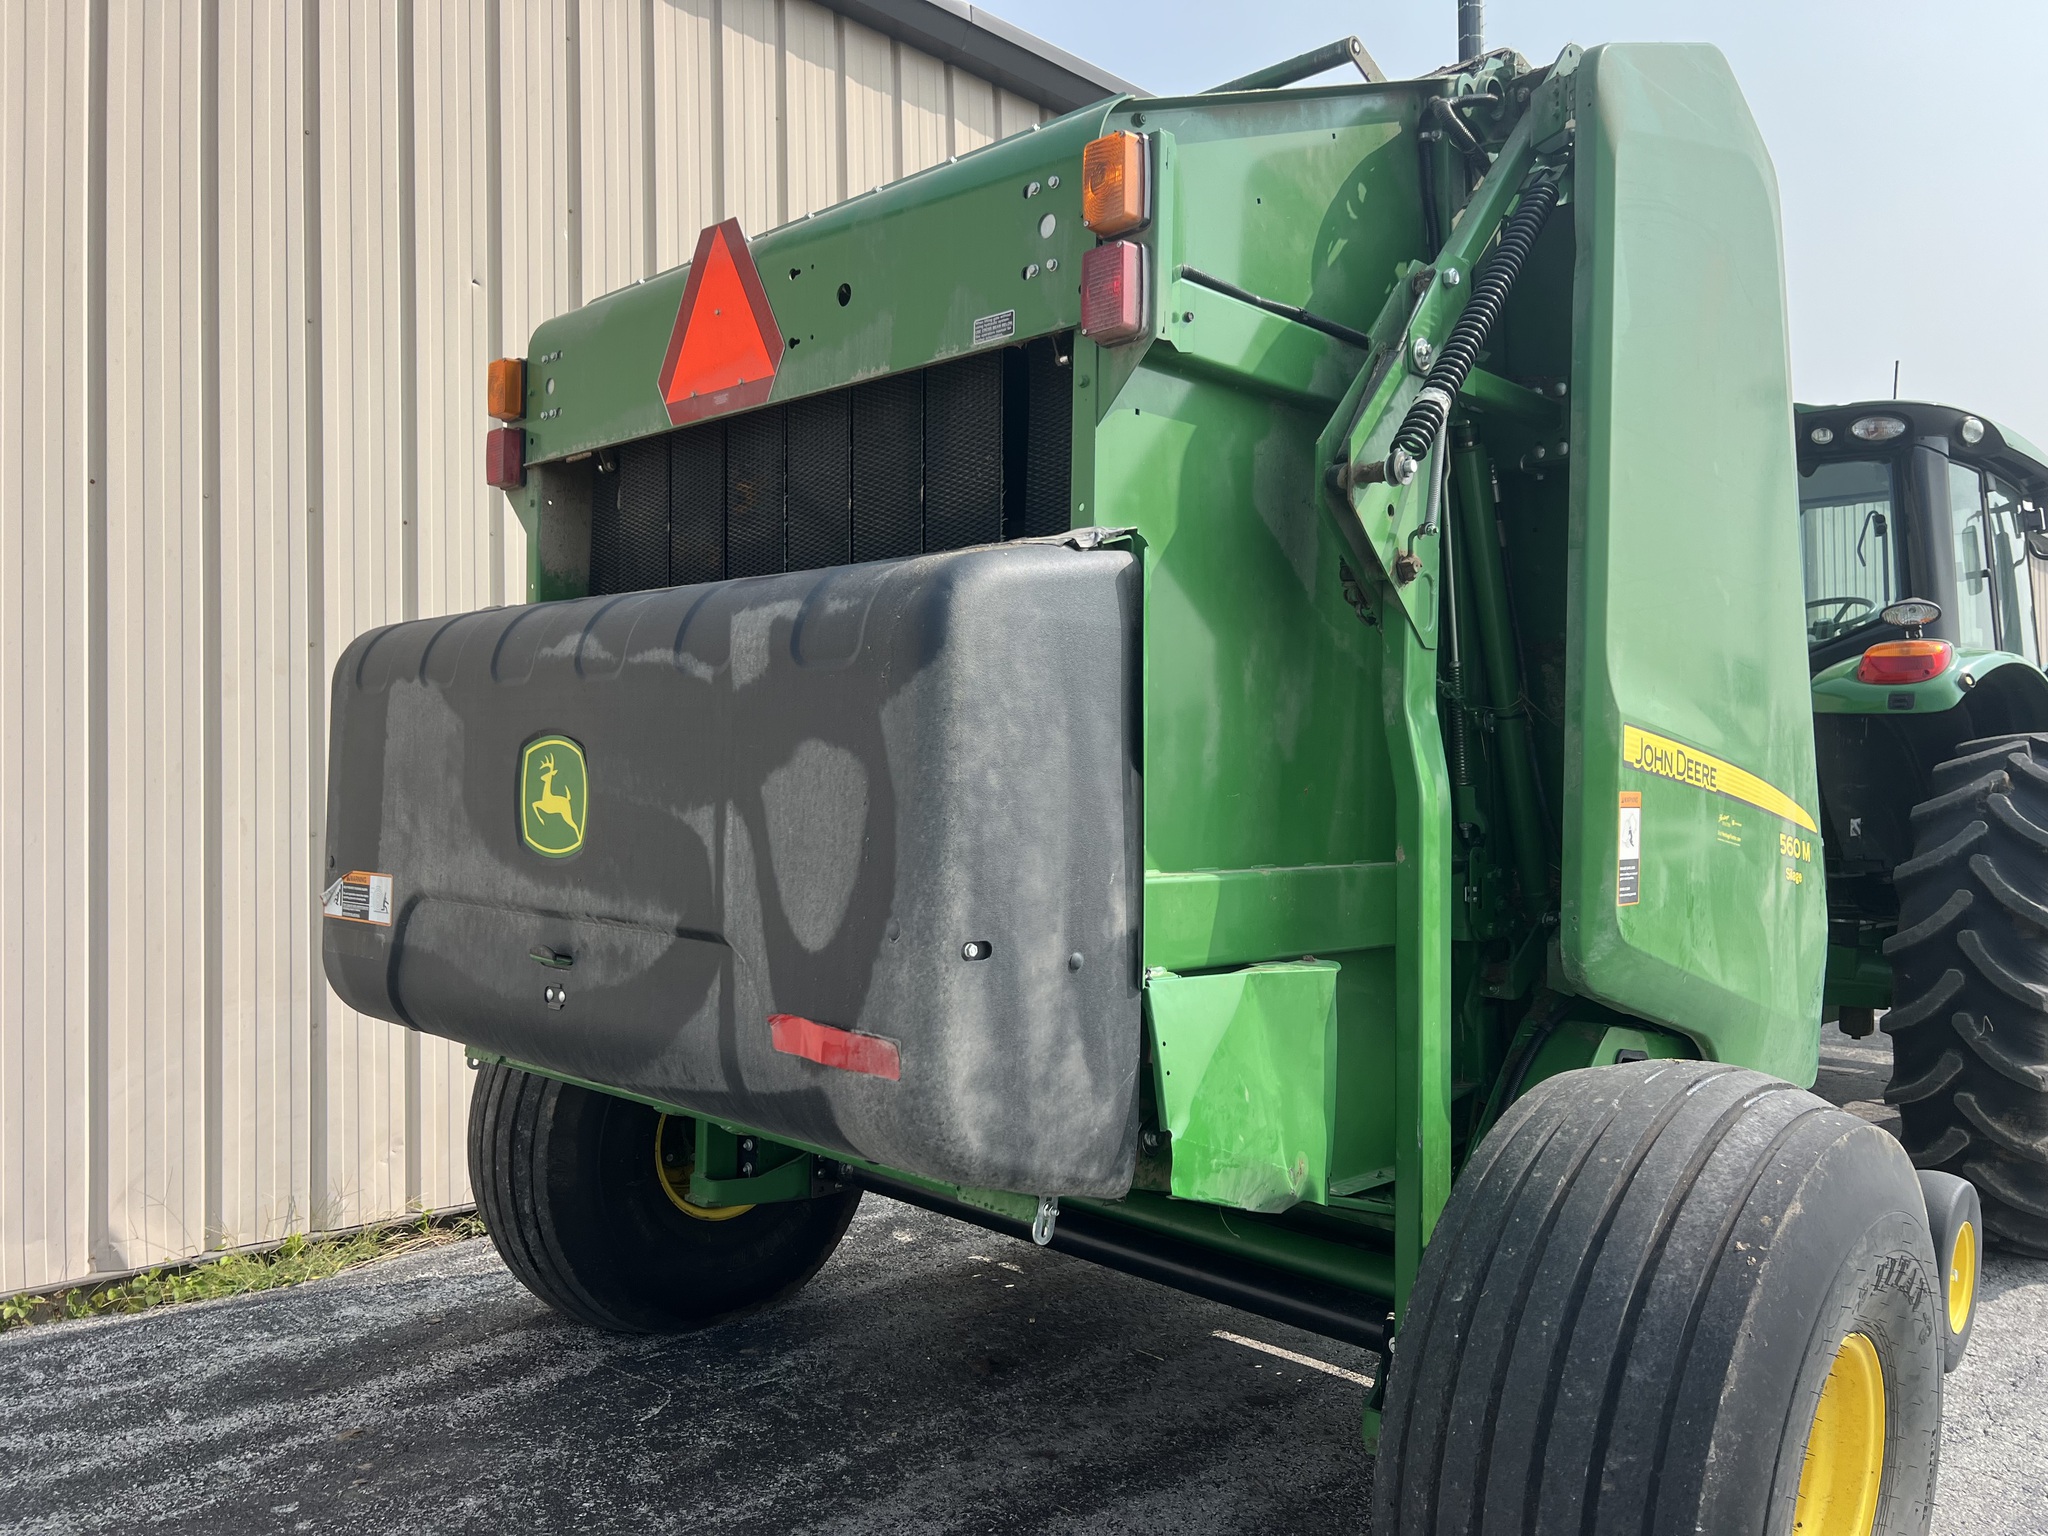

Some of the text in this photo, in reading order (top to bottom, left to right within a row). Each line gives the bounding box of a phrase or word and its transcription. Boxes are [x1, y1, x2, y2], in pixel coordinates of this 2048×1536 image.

[1635, 737, 1717, 788] JOHN DEERE
[1780, 832, 1801, 860] 560
